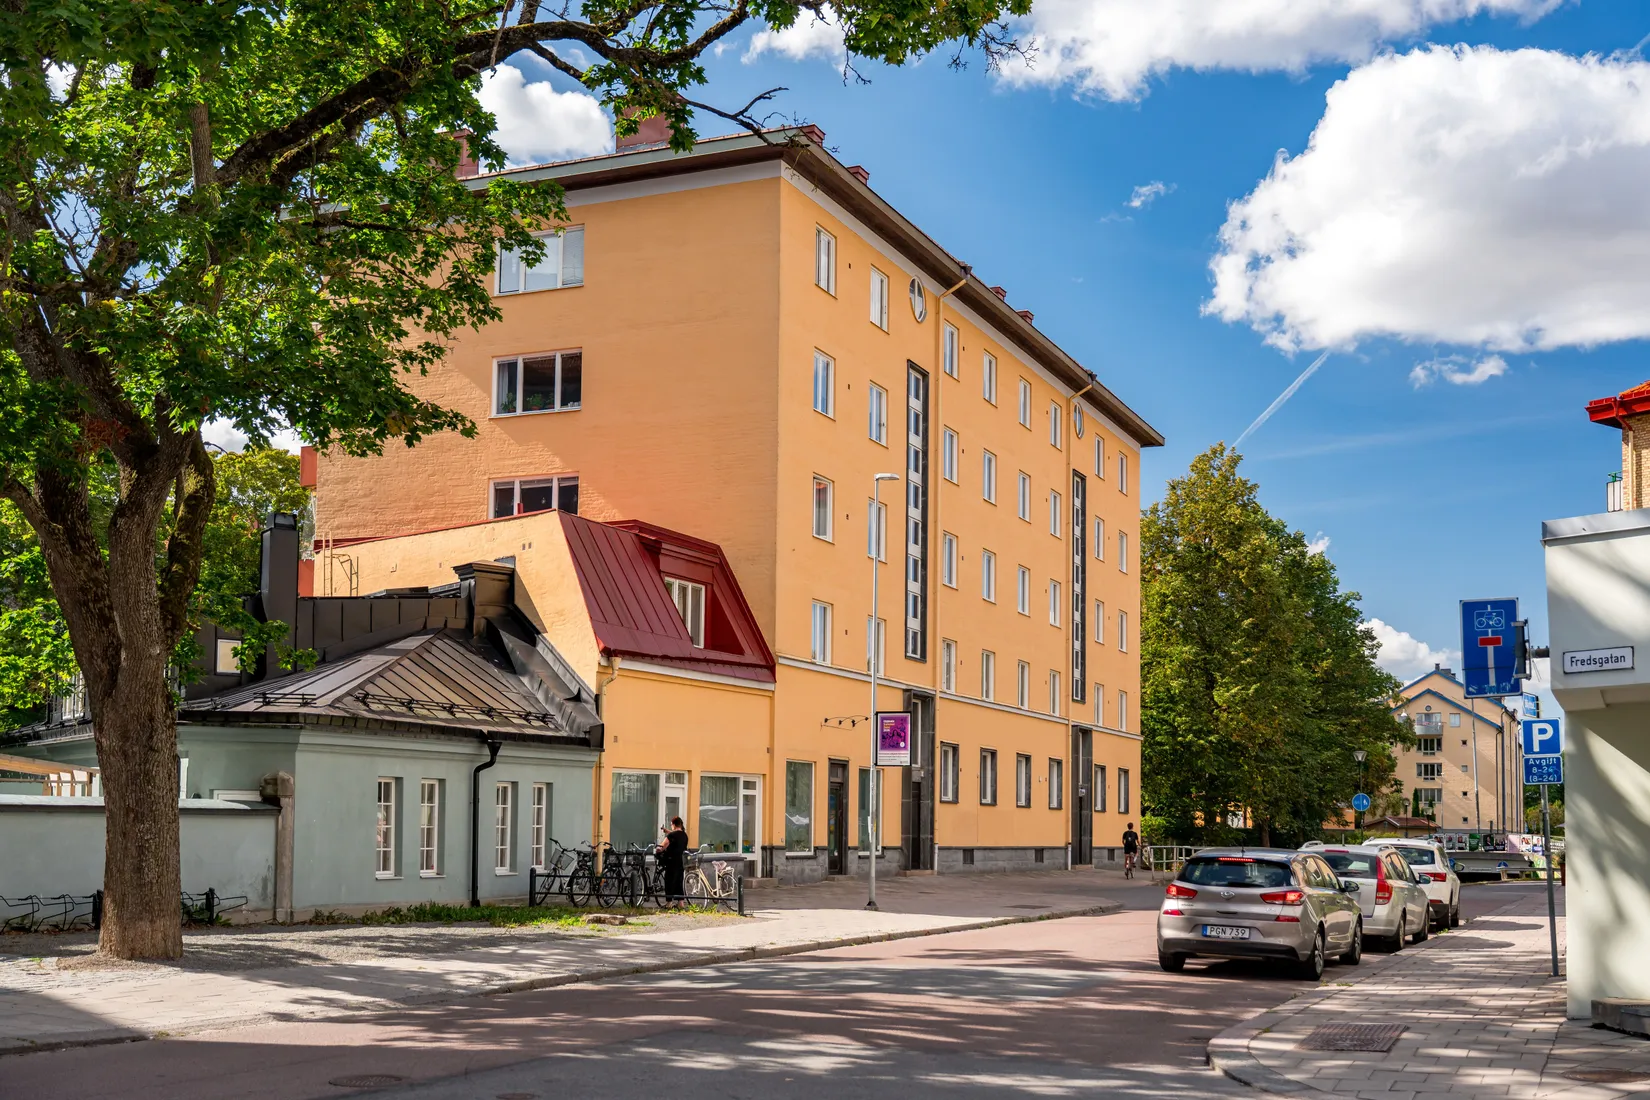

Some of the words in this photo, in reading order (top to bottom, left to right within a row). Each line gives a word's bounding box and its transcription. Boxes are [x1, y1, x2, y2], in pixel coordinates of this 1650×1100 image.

[1570, 653, 1626, 668] Fredsgatan
[1532, 723, 1553, 752] P
[1528, 757, 1557, 766] Avgift
[1529, 774, 1557, 783] (8-24)
[1209, 926, 1226, 936] PGN
[1229, 927, 1246, 937] 739
